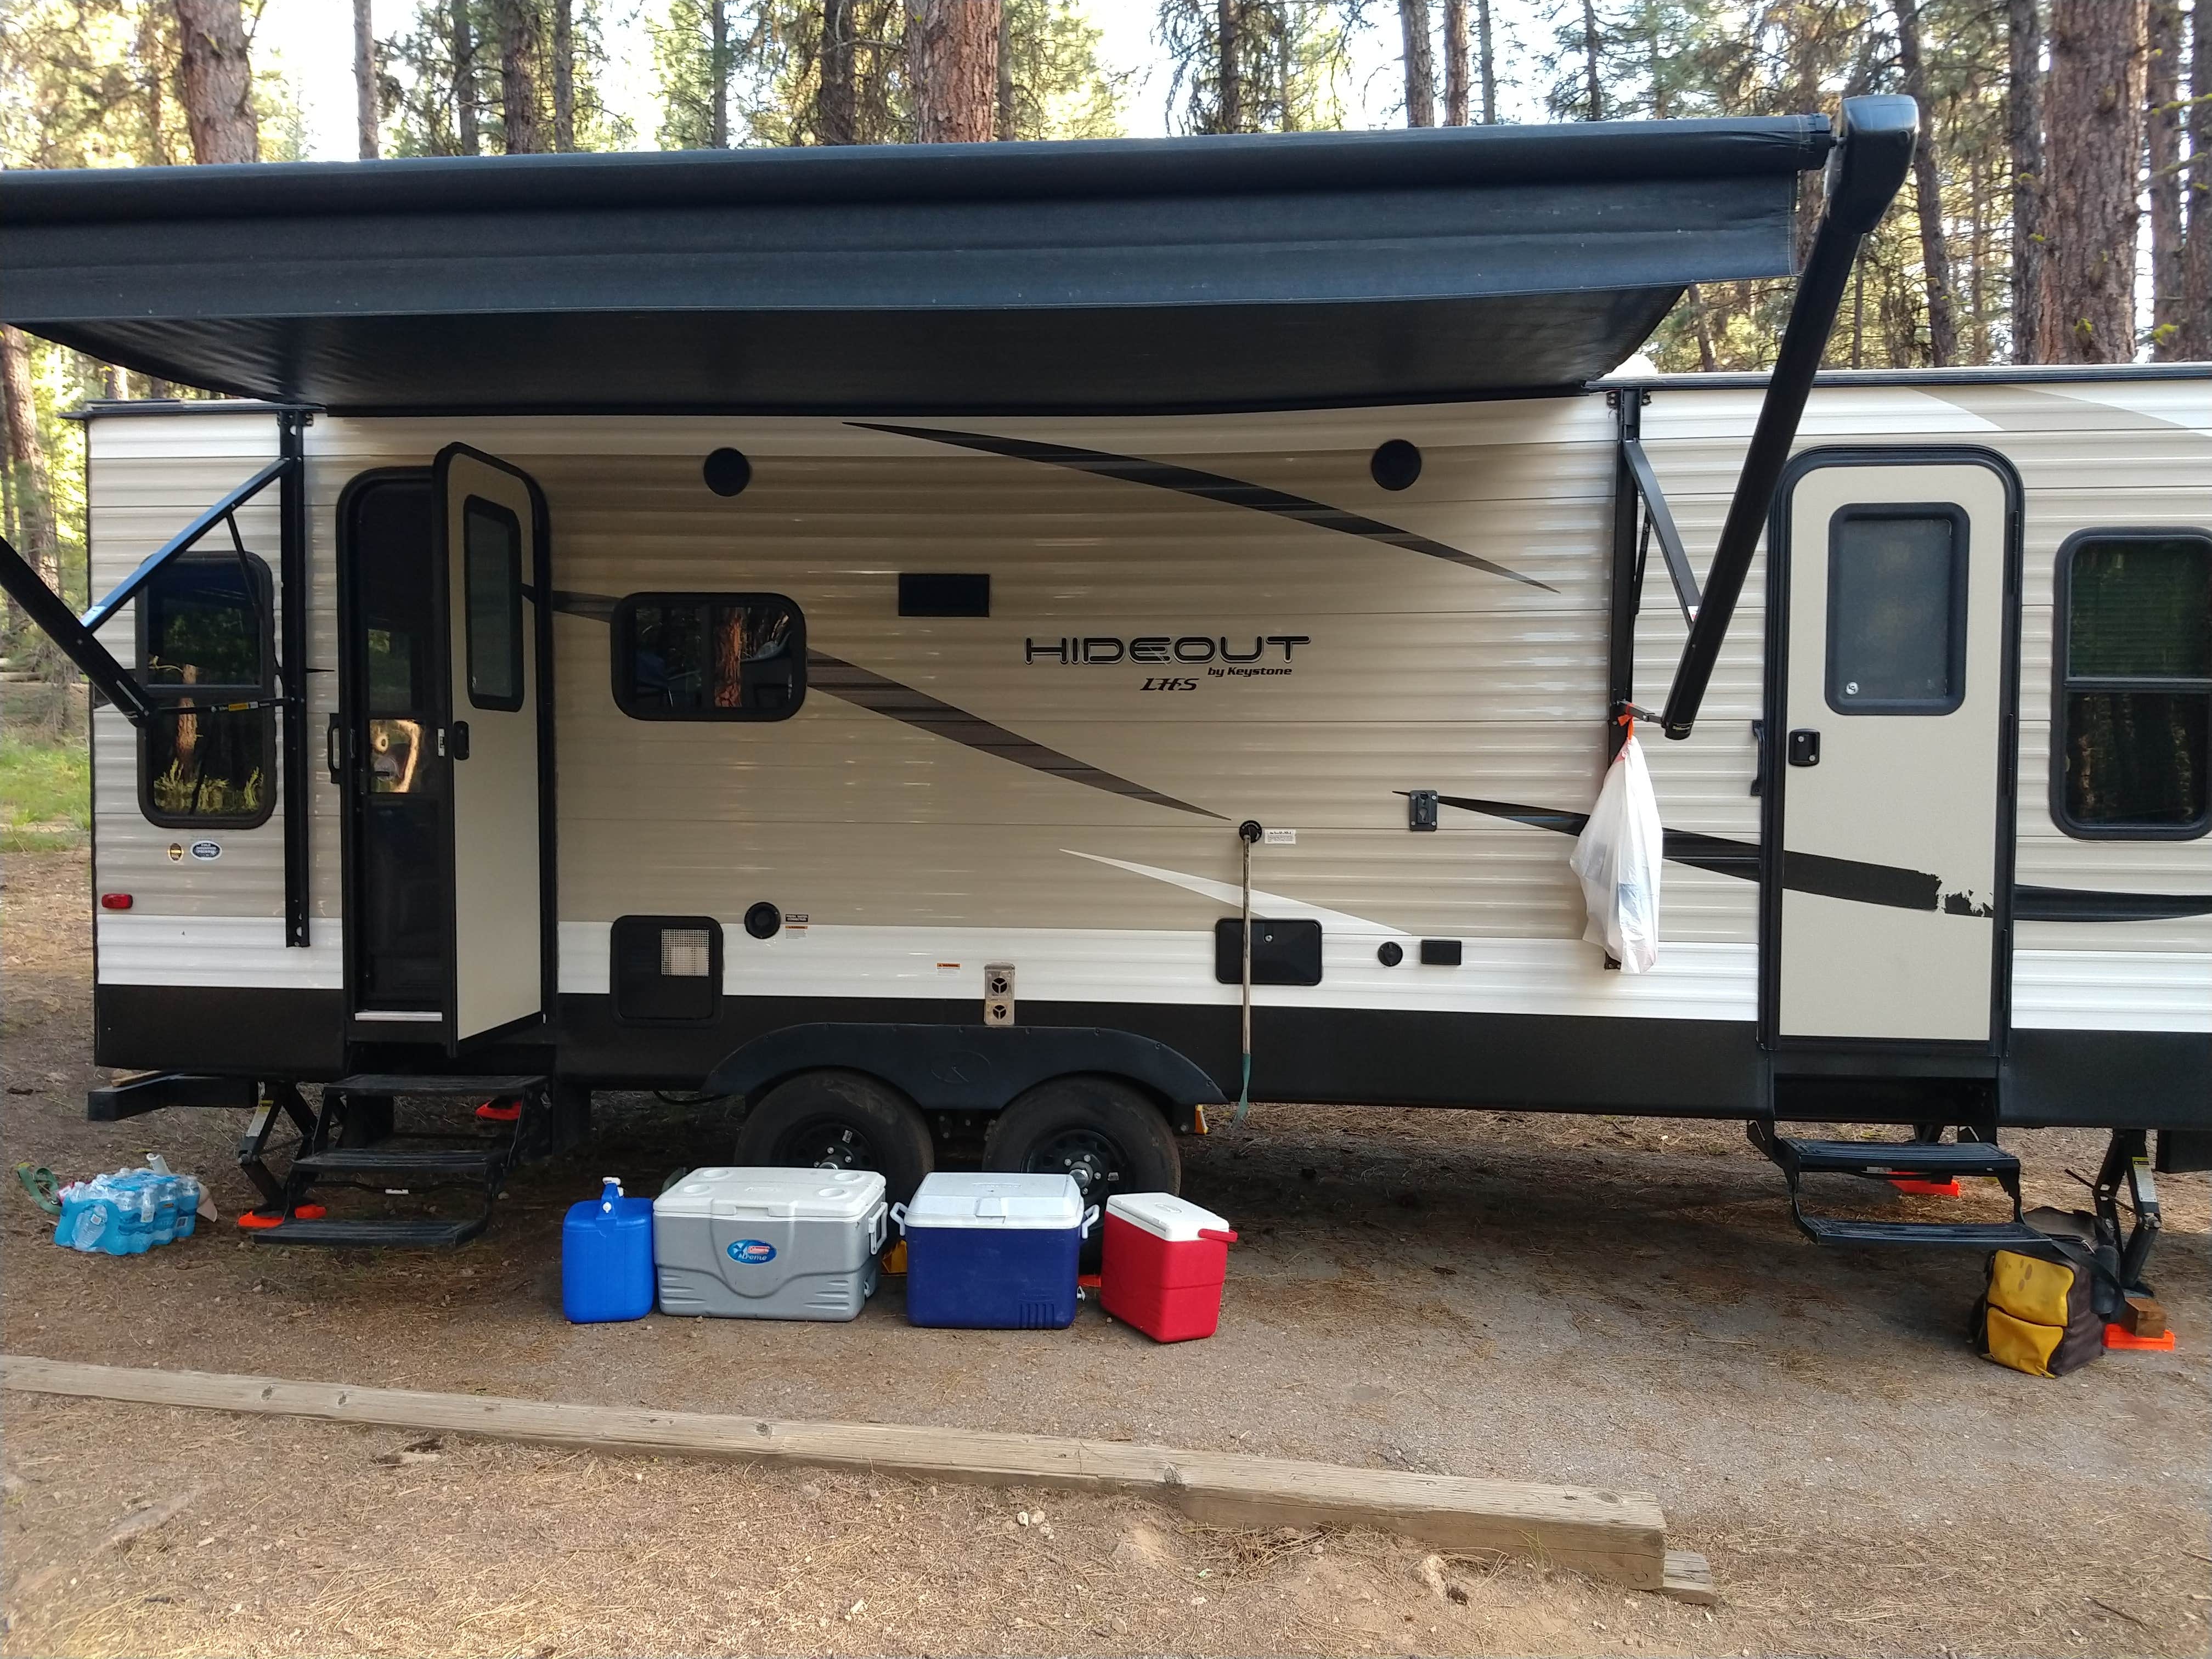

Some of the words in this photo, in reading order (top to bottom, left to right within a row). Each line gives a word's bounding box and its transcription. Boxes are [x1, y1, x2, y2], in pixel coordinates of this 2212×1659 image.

[1025, 636, 1311, 664] HIDEOUT
[1207, 667, 1224, 678] by
[1227, 667, 1293, 677] Keystone
[1139, 678, 1200, 691] LHS
